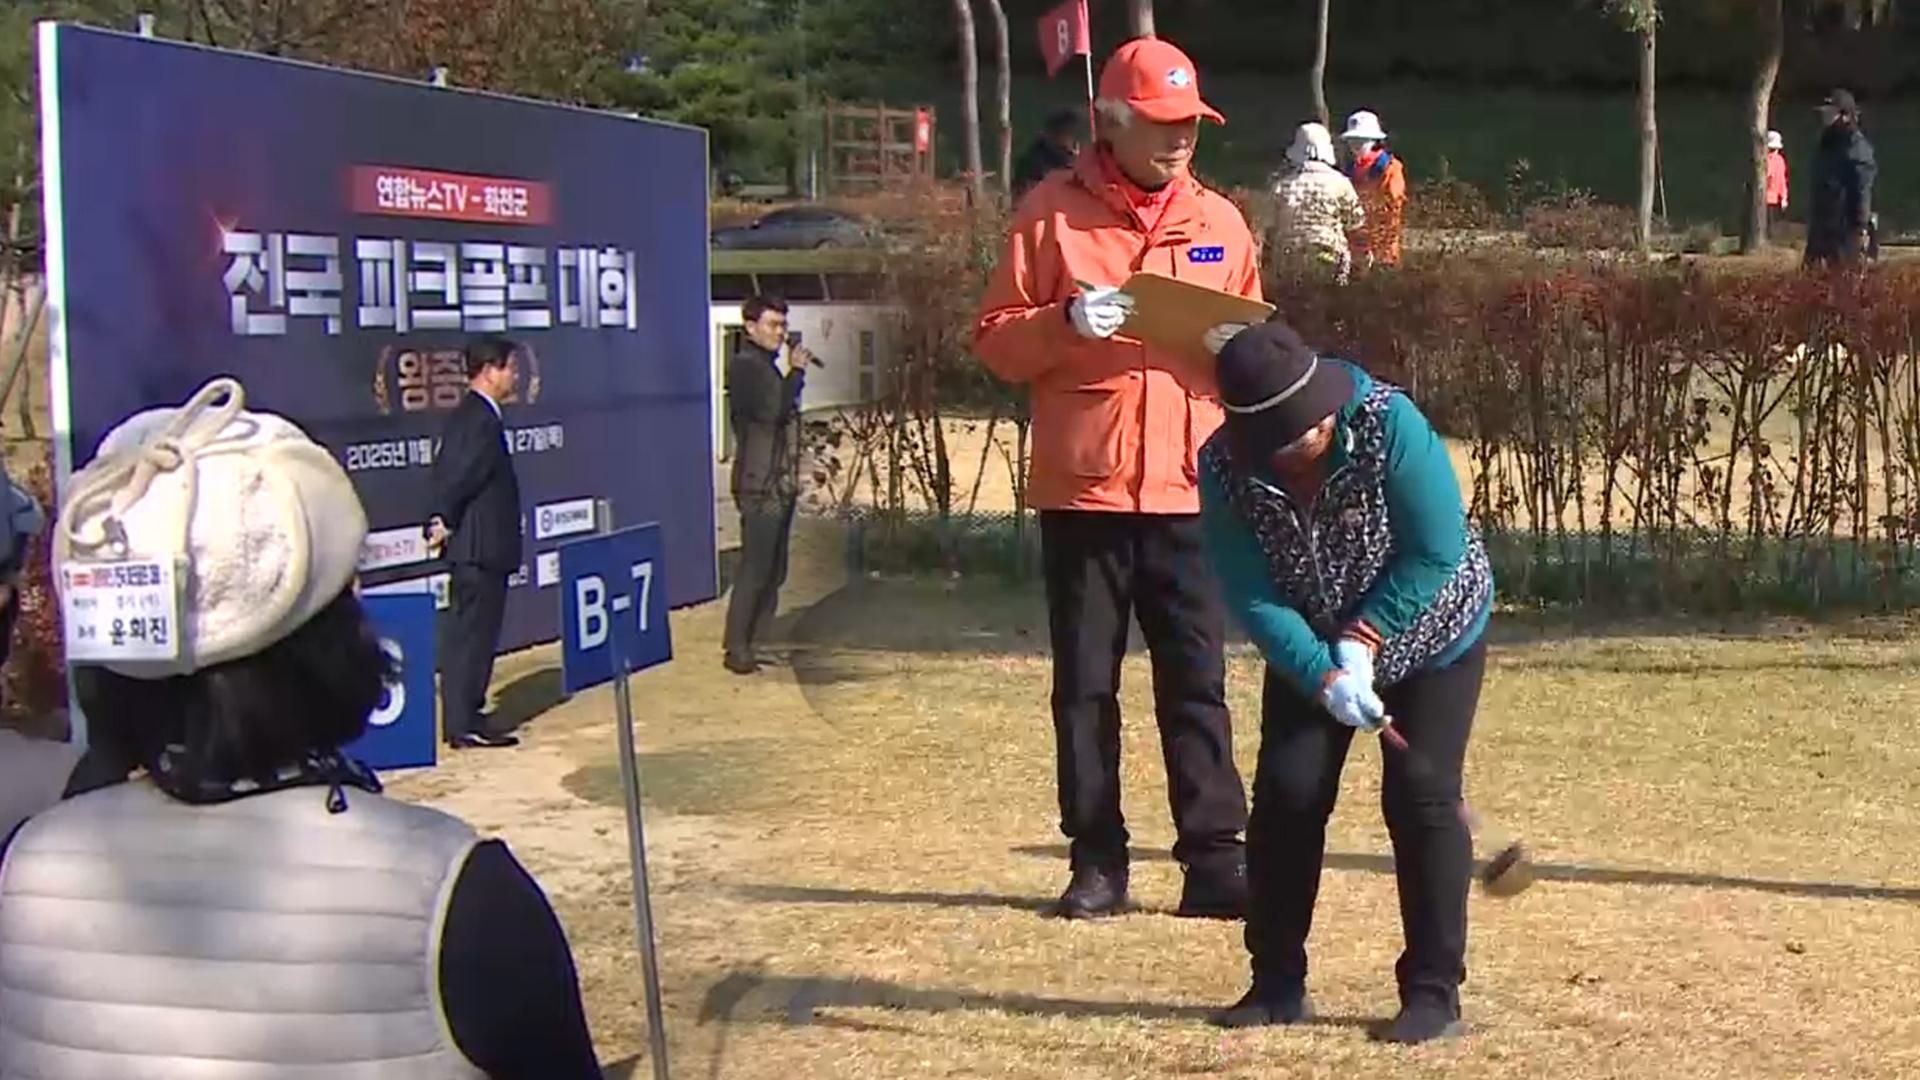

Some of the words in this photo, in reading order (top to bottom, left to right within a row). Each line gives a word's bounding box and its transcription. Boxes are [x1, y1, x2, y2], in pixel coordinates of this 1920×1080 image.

[376, 175, 467, 212] 연합뉴스TV
[484, 186, 529, 217] 화천군
[223, 230, 344, 336] 전국
[355, 236, 552, 334] 파크골프
[557, 245, 638, 332] 대회
[346, 440, 405, 471] 2025년
[575, 561, 653, 651] B-7
